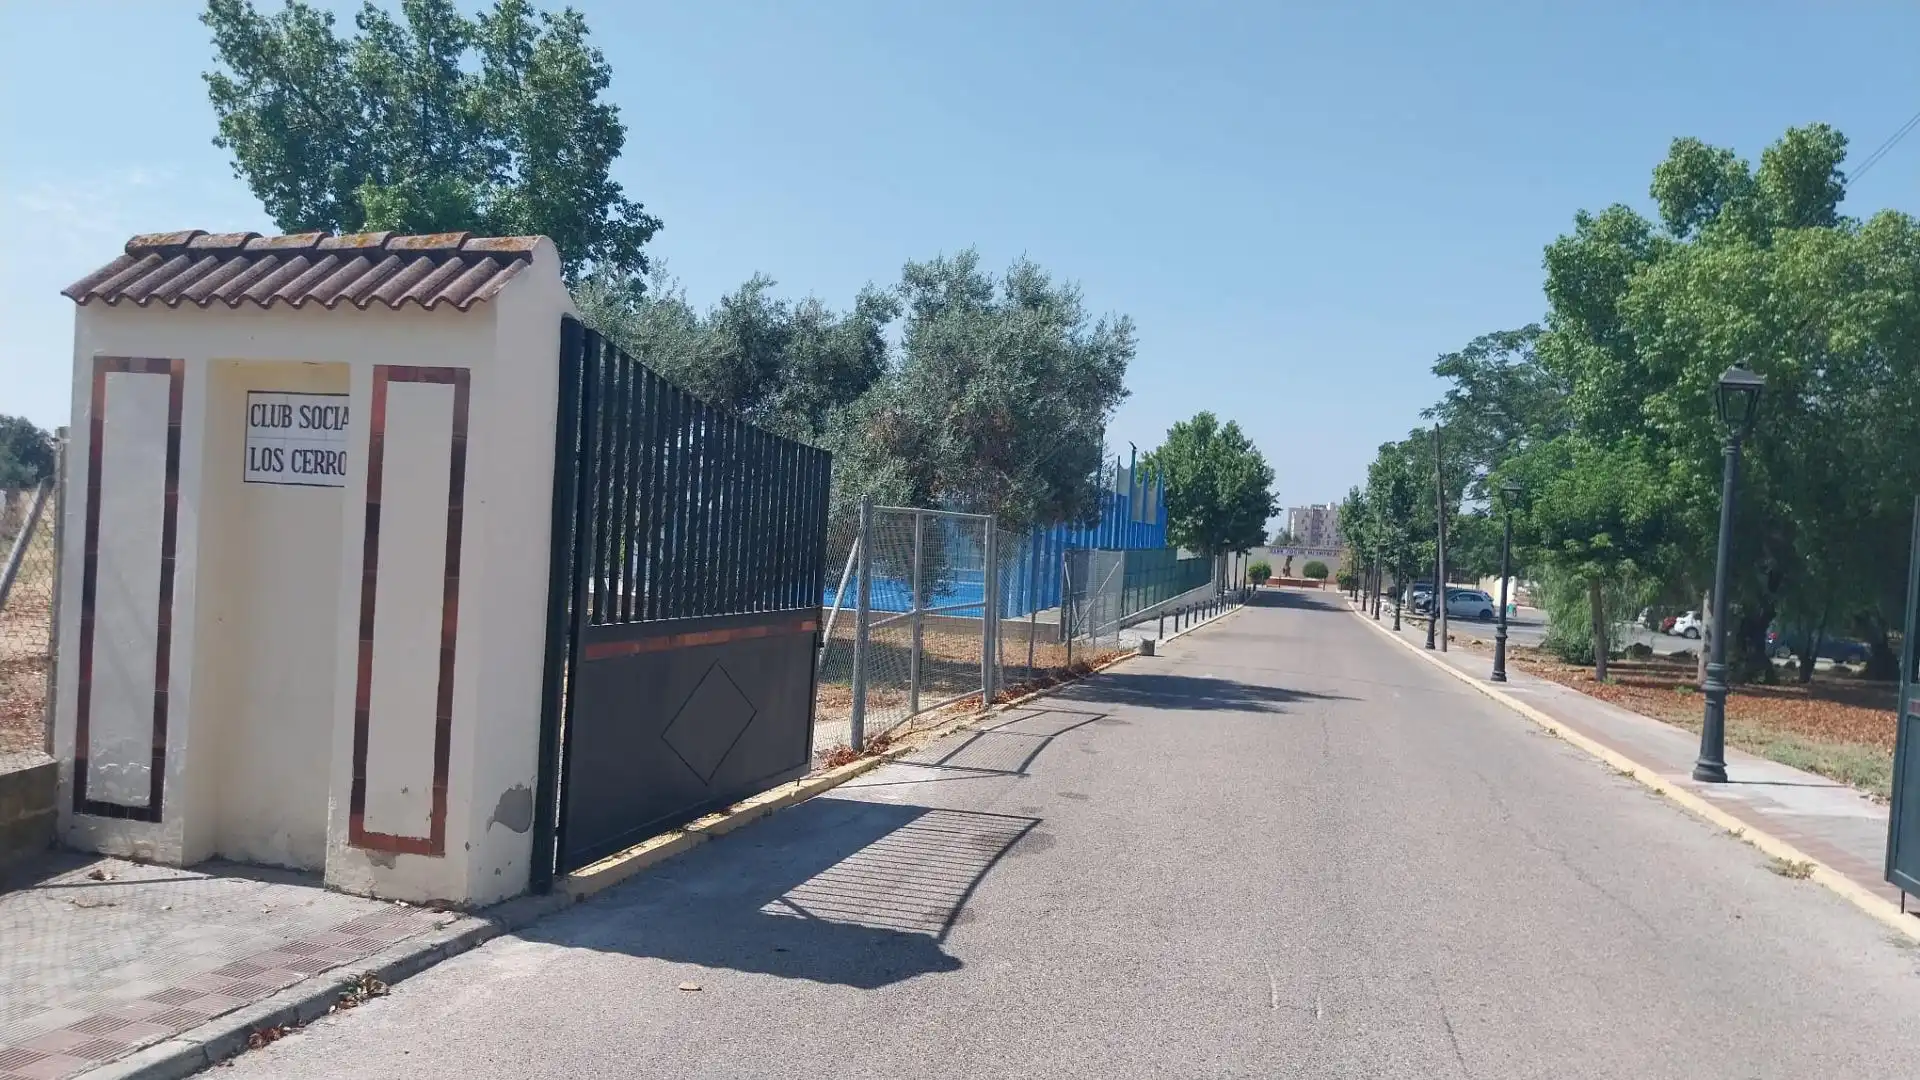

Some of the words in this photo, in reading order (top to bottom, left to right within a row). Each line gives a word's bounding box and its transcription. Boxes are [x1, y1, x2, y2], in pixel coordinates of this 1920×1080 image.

[250, 403, 292, 428] CLUB
[249, 446, 284, 473] LOS
[291, 449, 347, 476] CERRO
